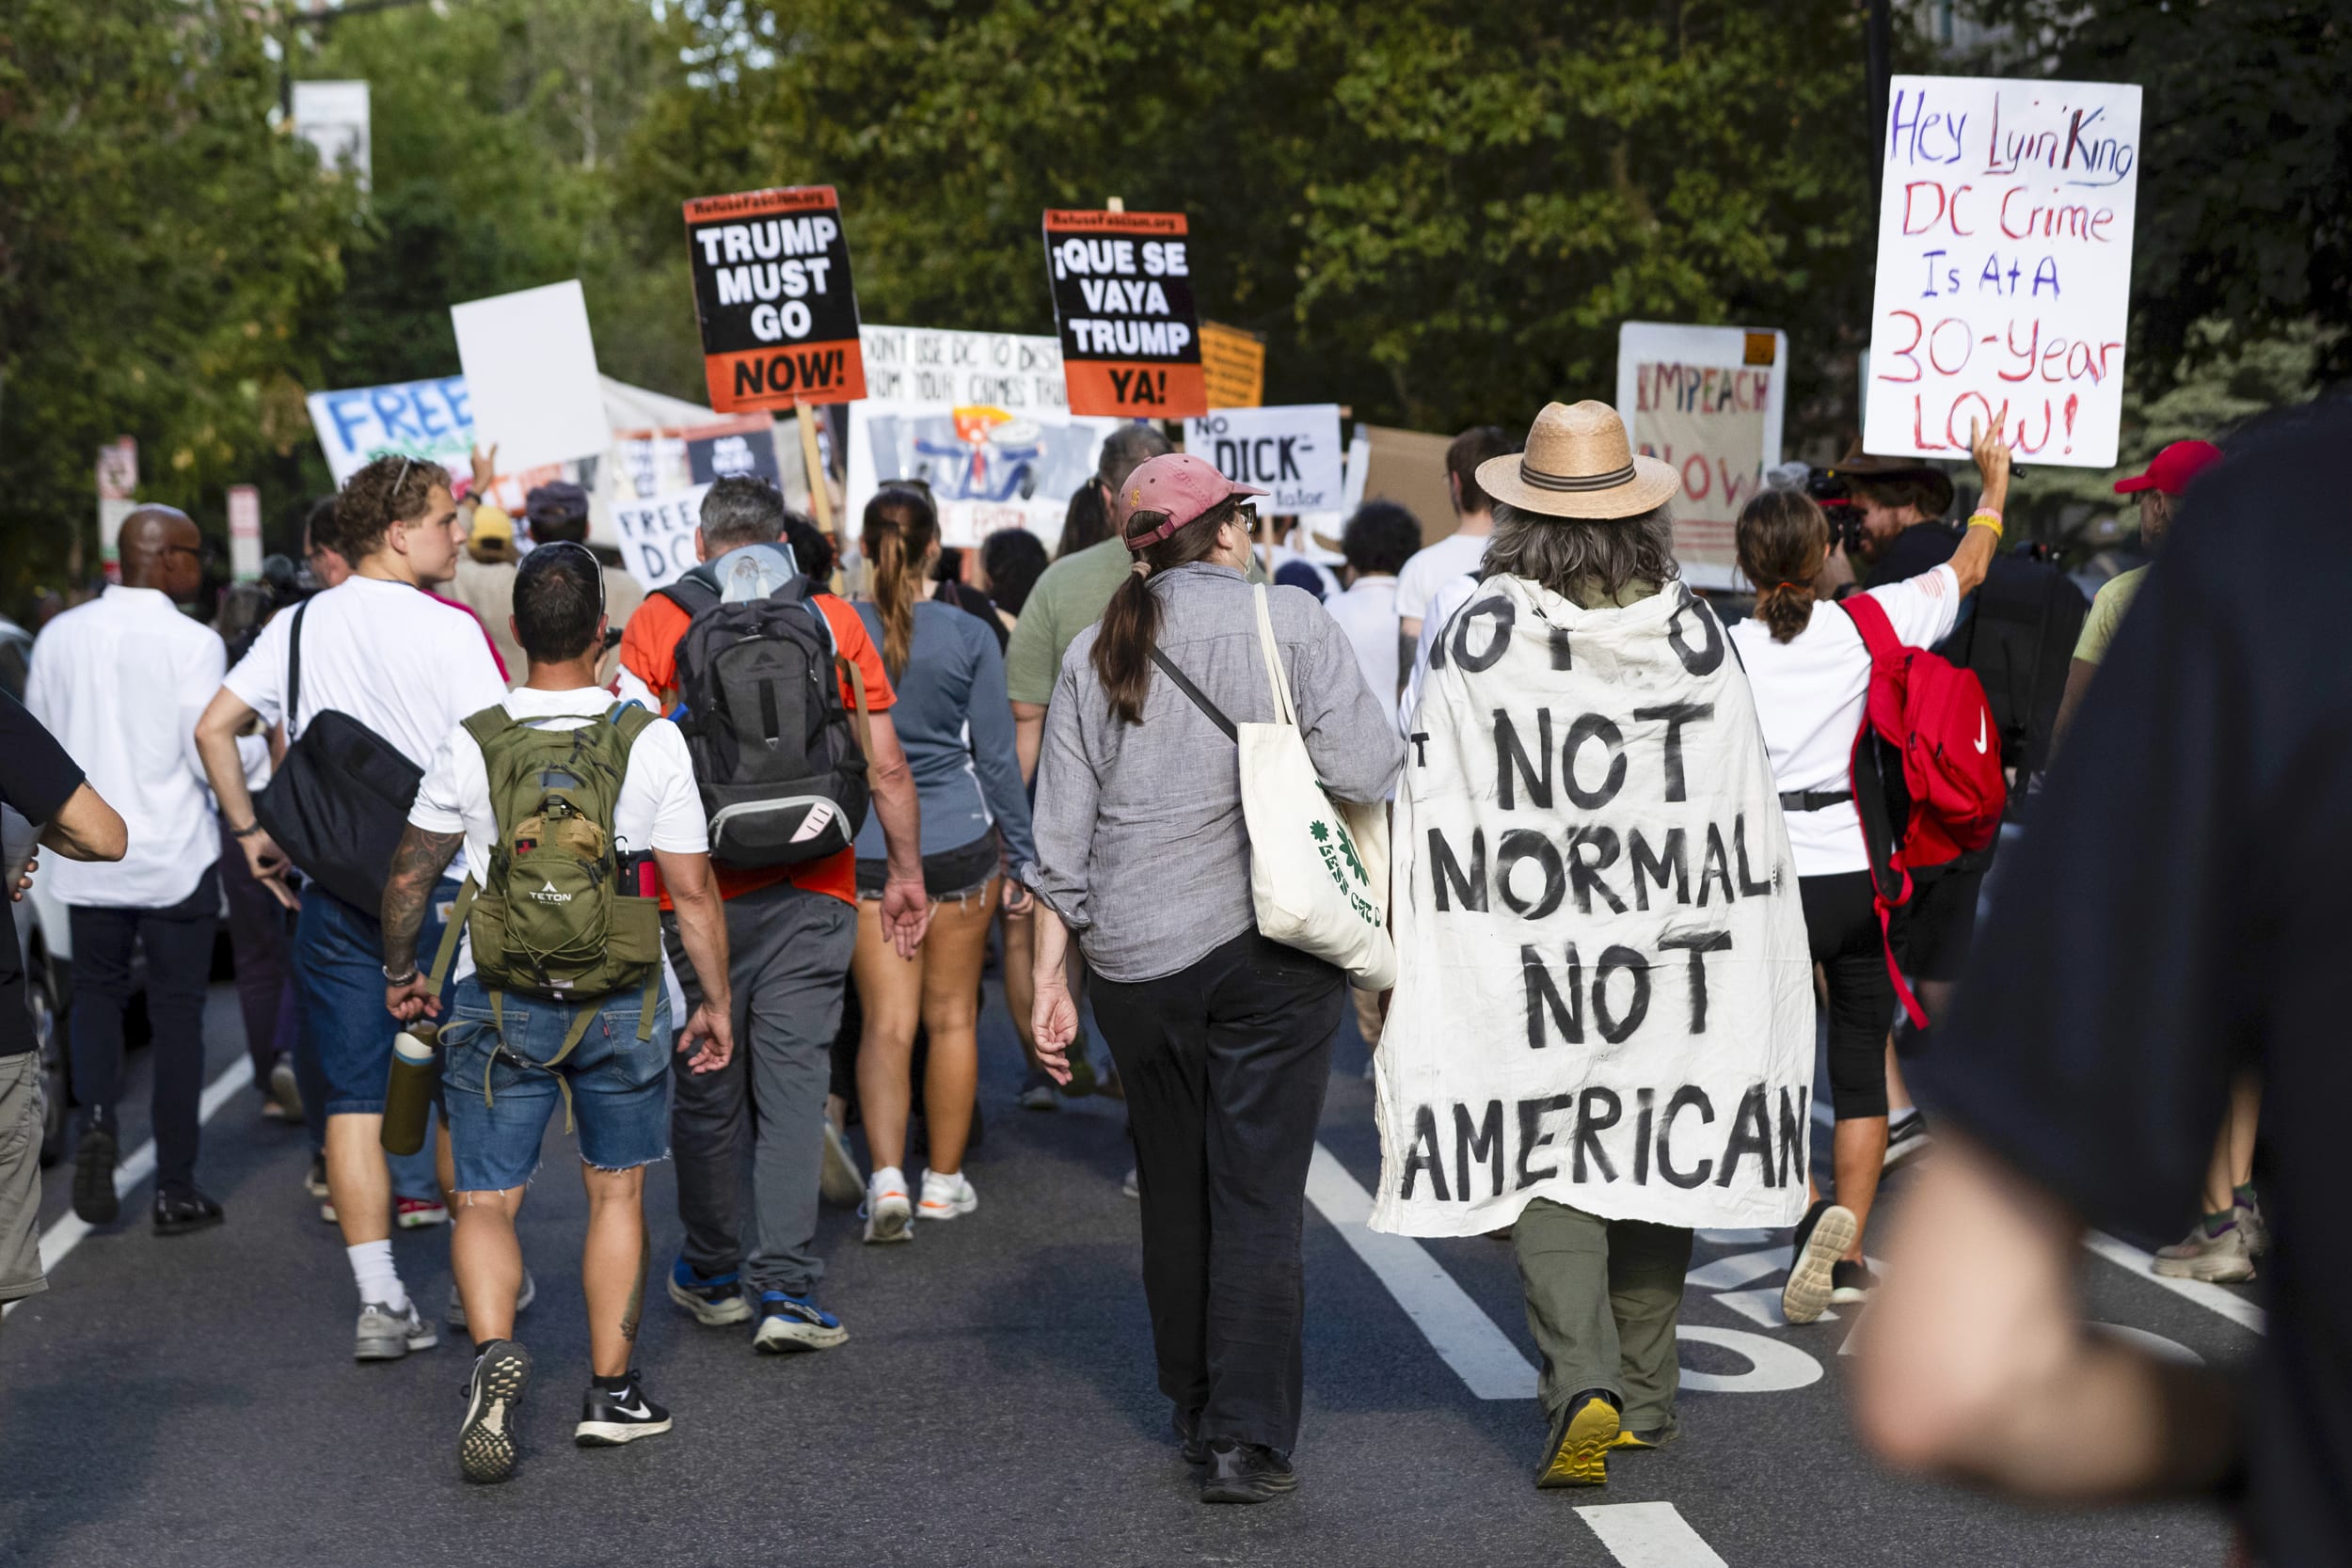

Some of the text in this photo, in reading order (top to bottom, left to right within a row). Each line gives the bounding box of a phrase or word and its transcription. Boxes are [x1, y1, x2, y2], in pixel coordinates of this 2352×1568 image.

[1891, 89, 1967, 165] Hey
[2062, 106, 2134, 186] King
[1902, 182, 2114, 242] DC Crime
[696, 215, 837, 265] TRUMP
[1053, 238, 1189, 279] ¡QUE SE
[716, 257, 831, 306] MUST
[1079, 279, 1170, 315] VAYA
[1921, 250, 1960, 298] Is
[2032, 256, 2060, 301] A
[751, 300, 812, 341] GO
[1069, 319, 1191, 356] TRUMP
[735, 350, 844, 397] NOW!
[1878, 310, 2122, 387] 30-Year
[1108, 369, 1168, 404] YA!
[1637, 361, 1770, 414] IMPEACH
[326, 376, 473, 453] FREE
[1195, 416, 1228, 436] NO
[1914, 391, 2078, 454] LOW!
[618, 500, 695, 538] FREE
[640, 533, 691, 578] DC
[1493, 704, 1715, 811] NOT
[1428, 814, 1772, 921] NORMAL
[528, 891, 572, 902] TETON
[1521, 929, 1733, 1048] NOT
[1400, 1083, 1808, 1202] AMERICAN
